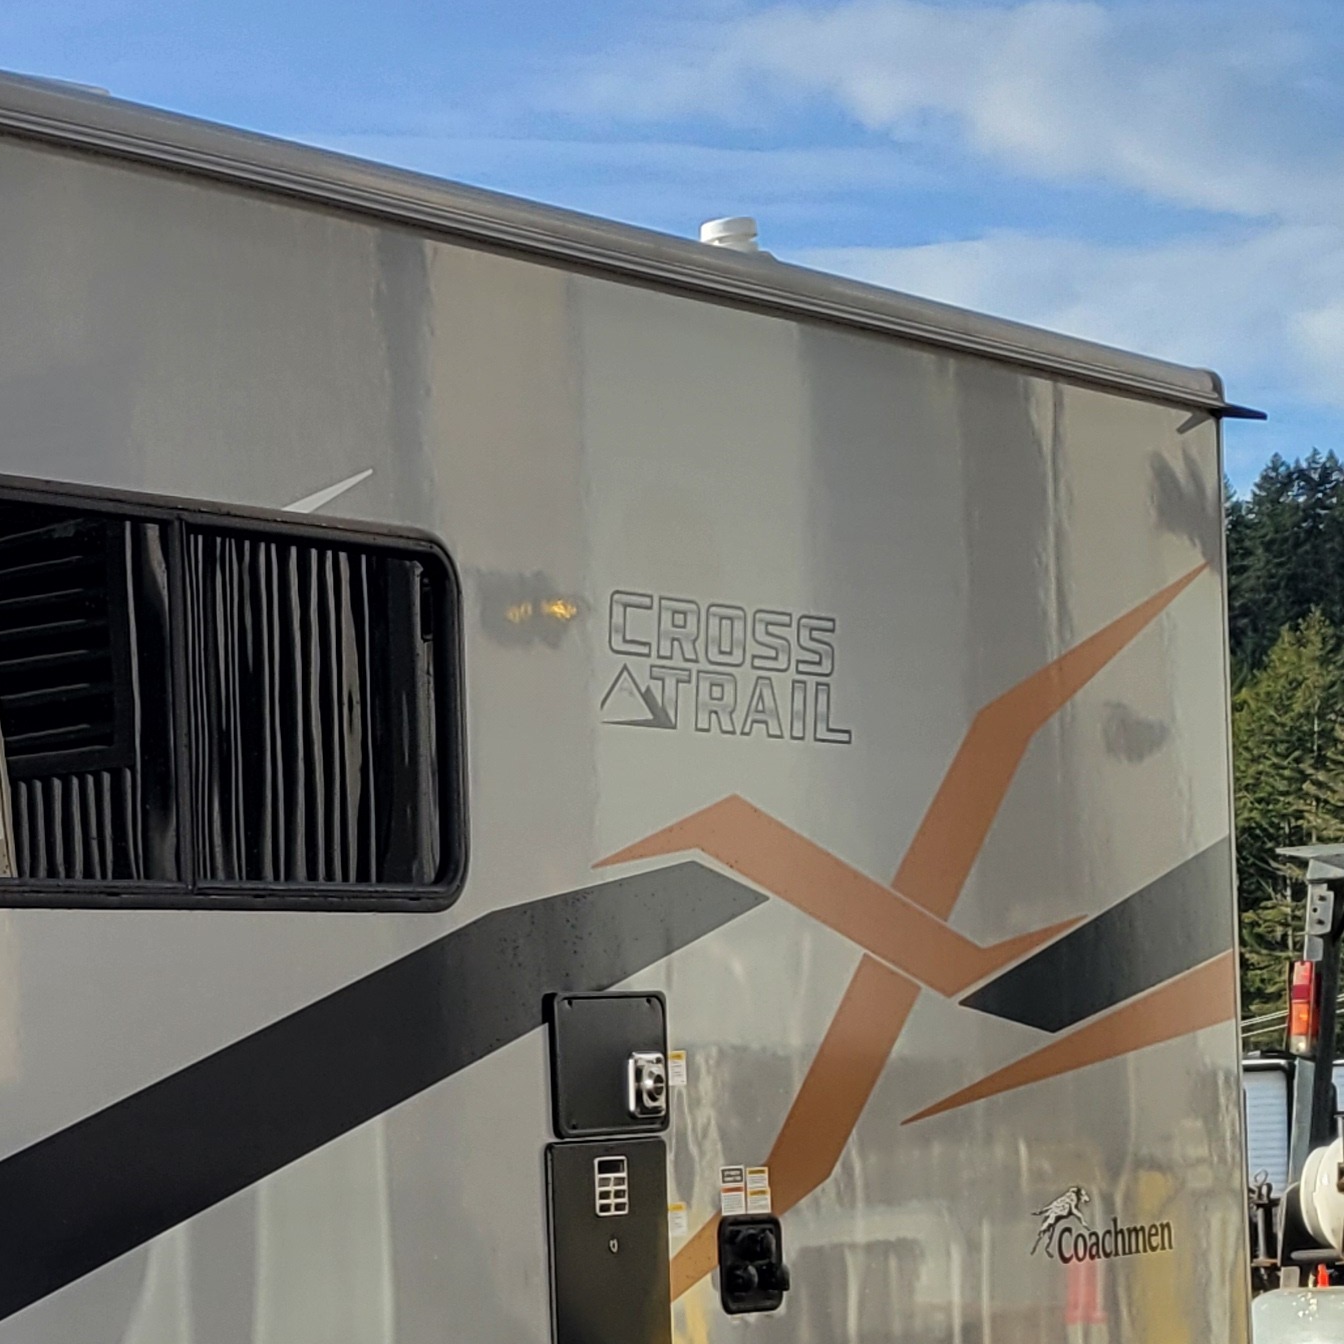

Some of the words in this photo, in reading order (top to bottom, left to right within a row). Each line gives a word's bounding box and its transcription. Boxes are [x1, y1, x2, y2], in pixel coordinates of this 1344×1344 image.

[608, 589, 837, 677] CROSS
[649, 664, 853, 745] TRAIL
[1057, 1217, 1174, 1264] Coachmen
